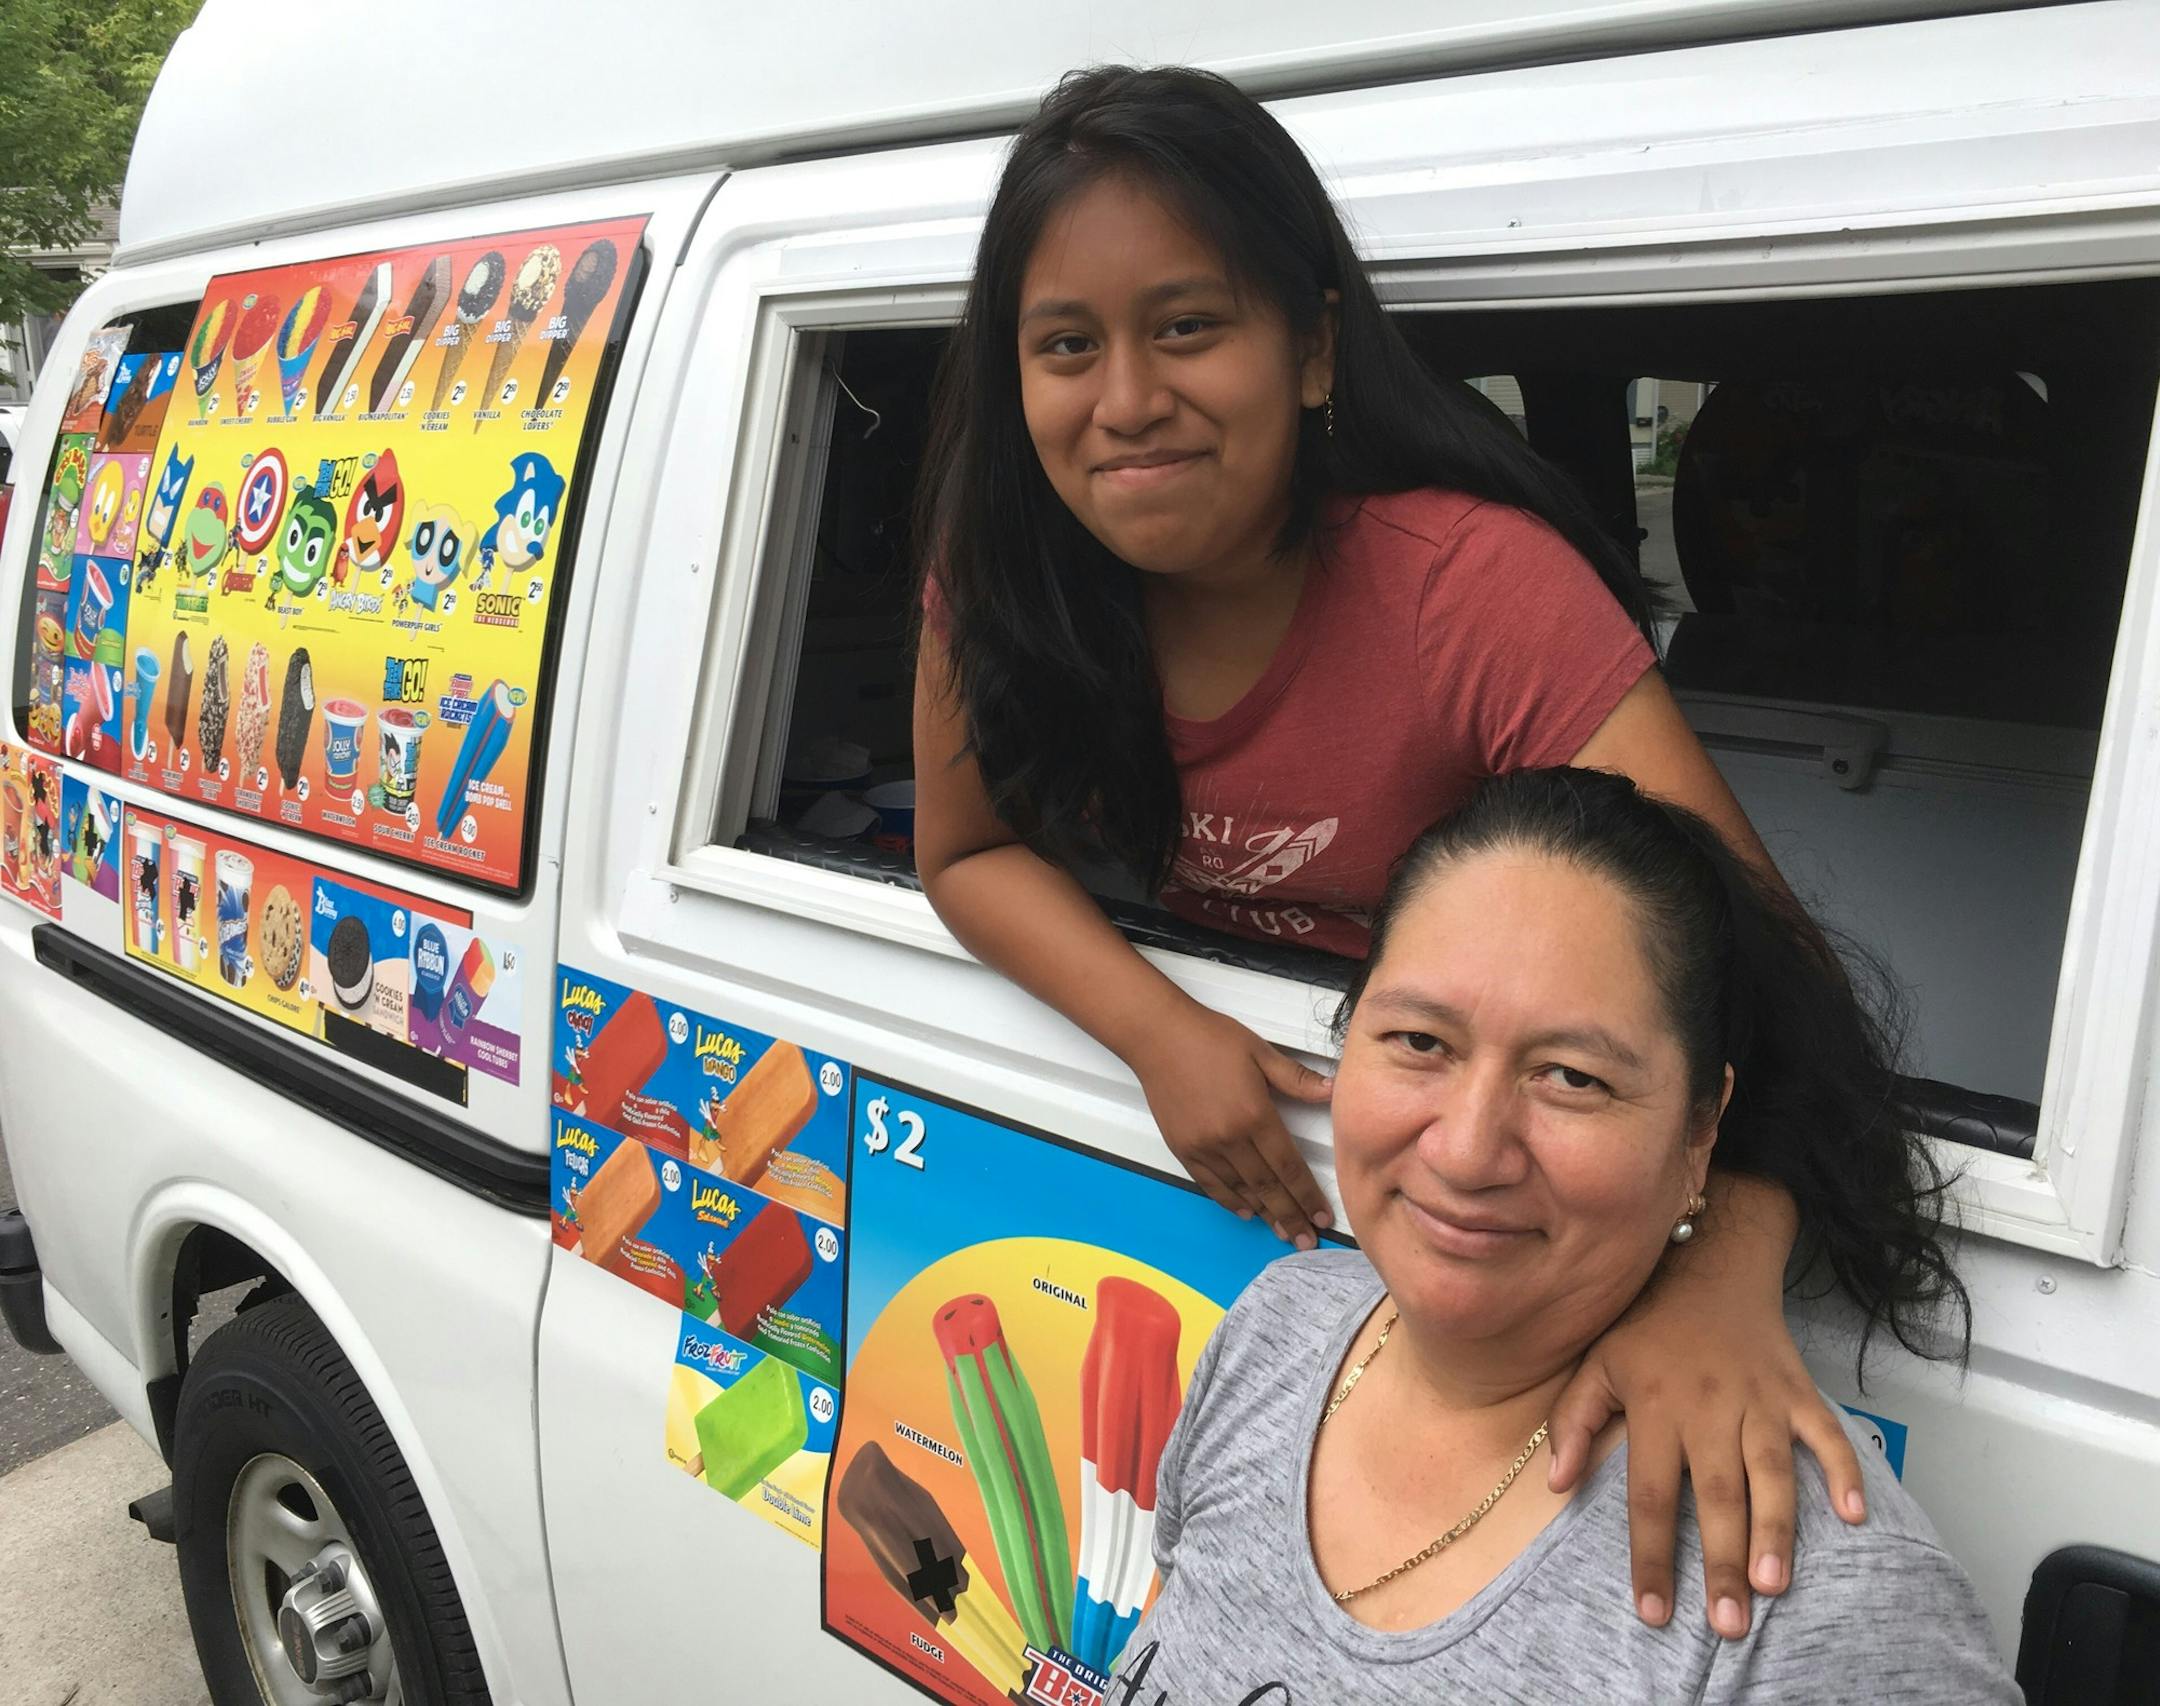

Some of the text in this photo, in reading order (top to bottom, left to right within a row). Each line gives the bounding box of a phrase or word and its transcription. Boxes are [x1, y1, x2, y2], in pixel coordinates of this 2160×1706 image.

[549, 316, 567, 329] BIG
[475, 593, 521, 617] SONIC
[423, 938, 440, 954] BLUE
[375, 982, 403, 1002] COOKIES
[562, 978, 606, 1015] Lucas
[670, 1018, 687, 1037] 2.00
[695, 1024, 746, 1065] Lucas
[703, 1056, 737, 1084] MANGO
[822, 1069, 841, 1089] 2.00
[557, 1119, 600, 1157] Lucas
[863, 1095, 926, 1171] $2
[663, 1168, 680, 1185] 2.00
[691, 1178, 742, 1221] Lucas
[817, 1234, 837, 1256] 2.00
[1032, 1277, 1089, 1310] ORIGINAL
[813, 1394, 833, 1416] 2.00
[894, 1421, 964, 1467] WATERMELON
[910, 1633, 945, 1663] FUDGE
[1051, 1649, 1073, 1667] THE
